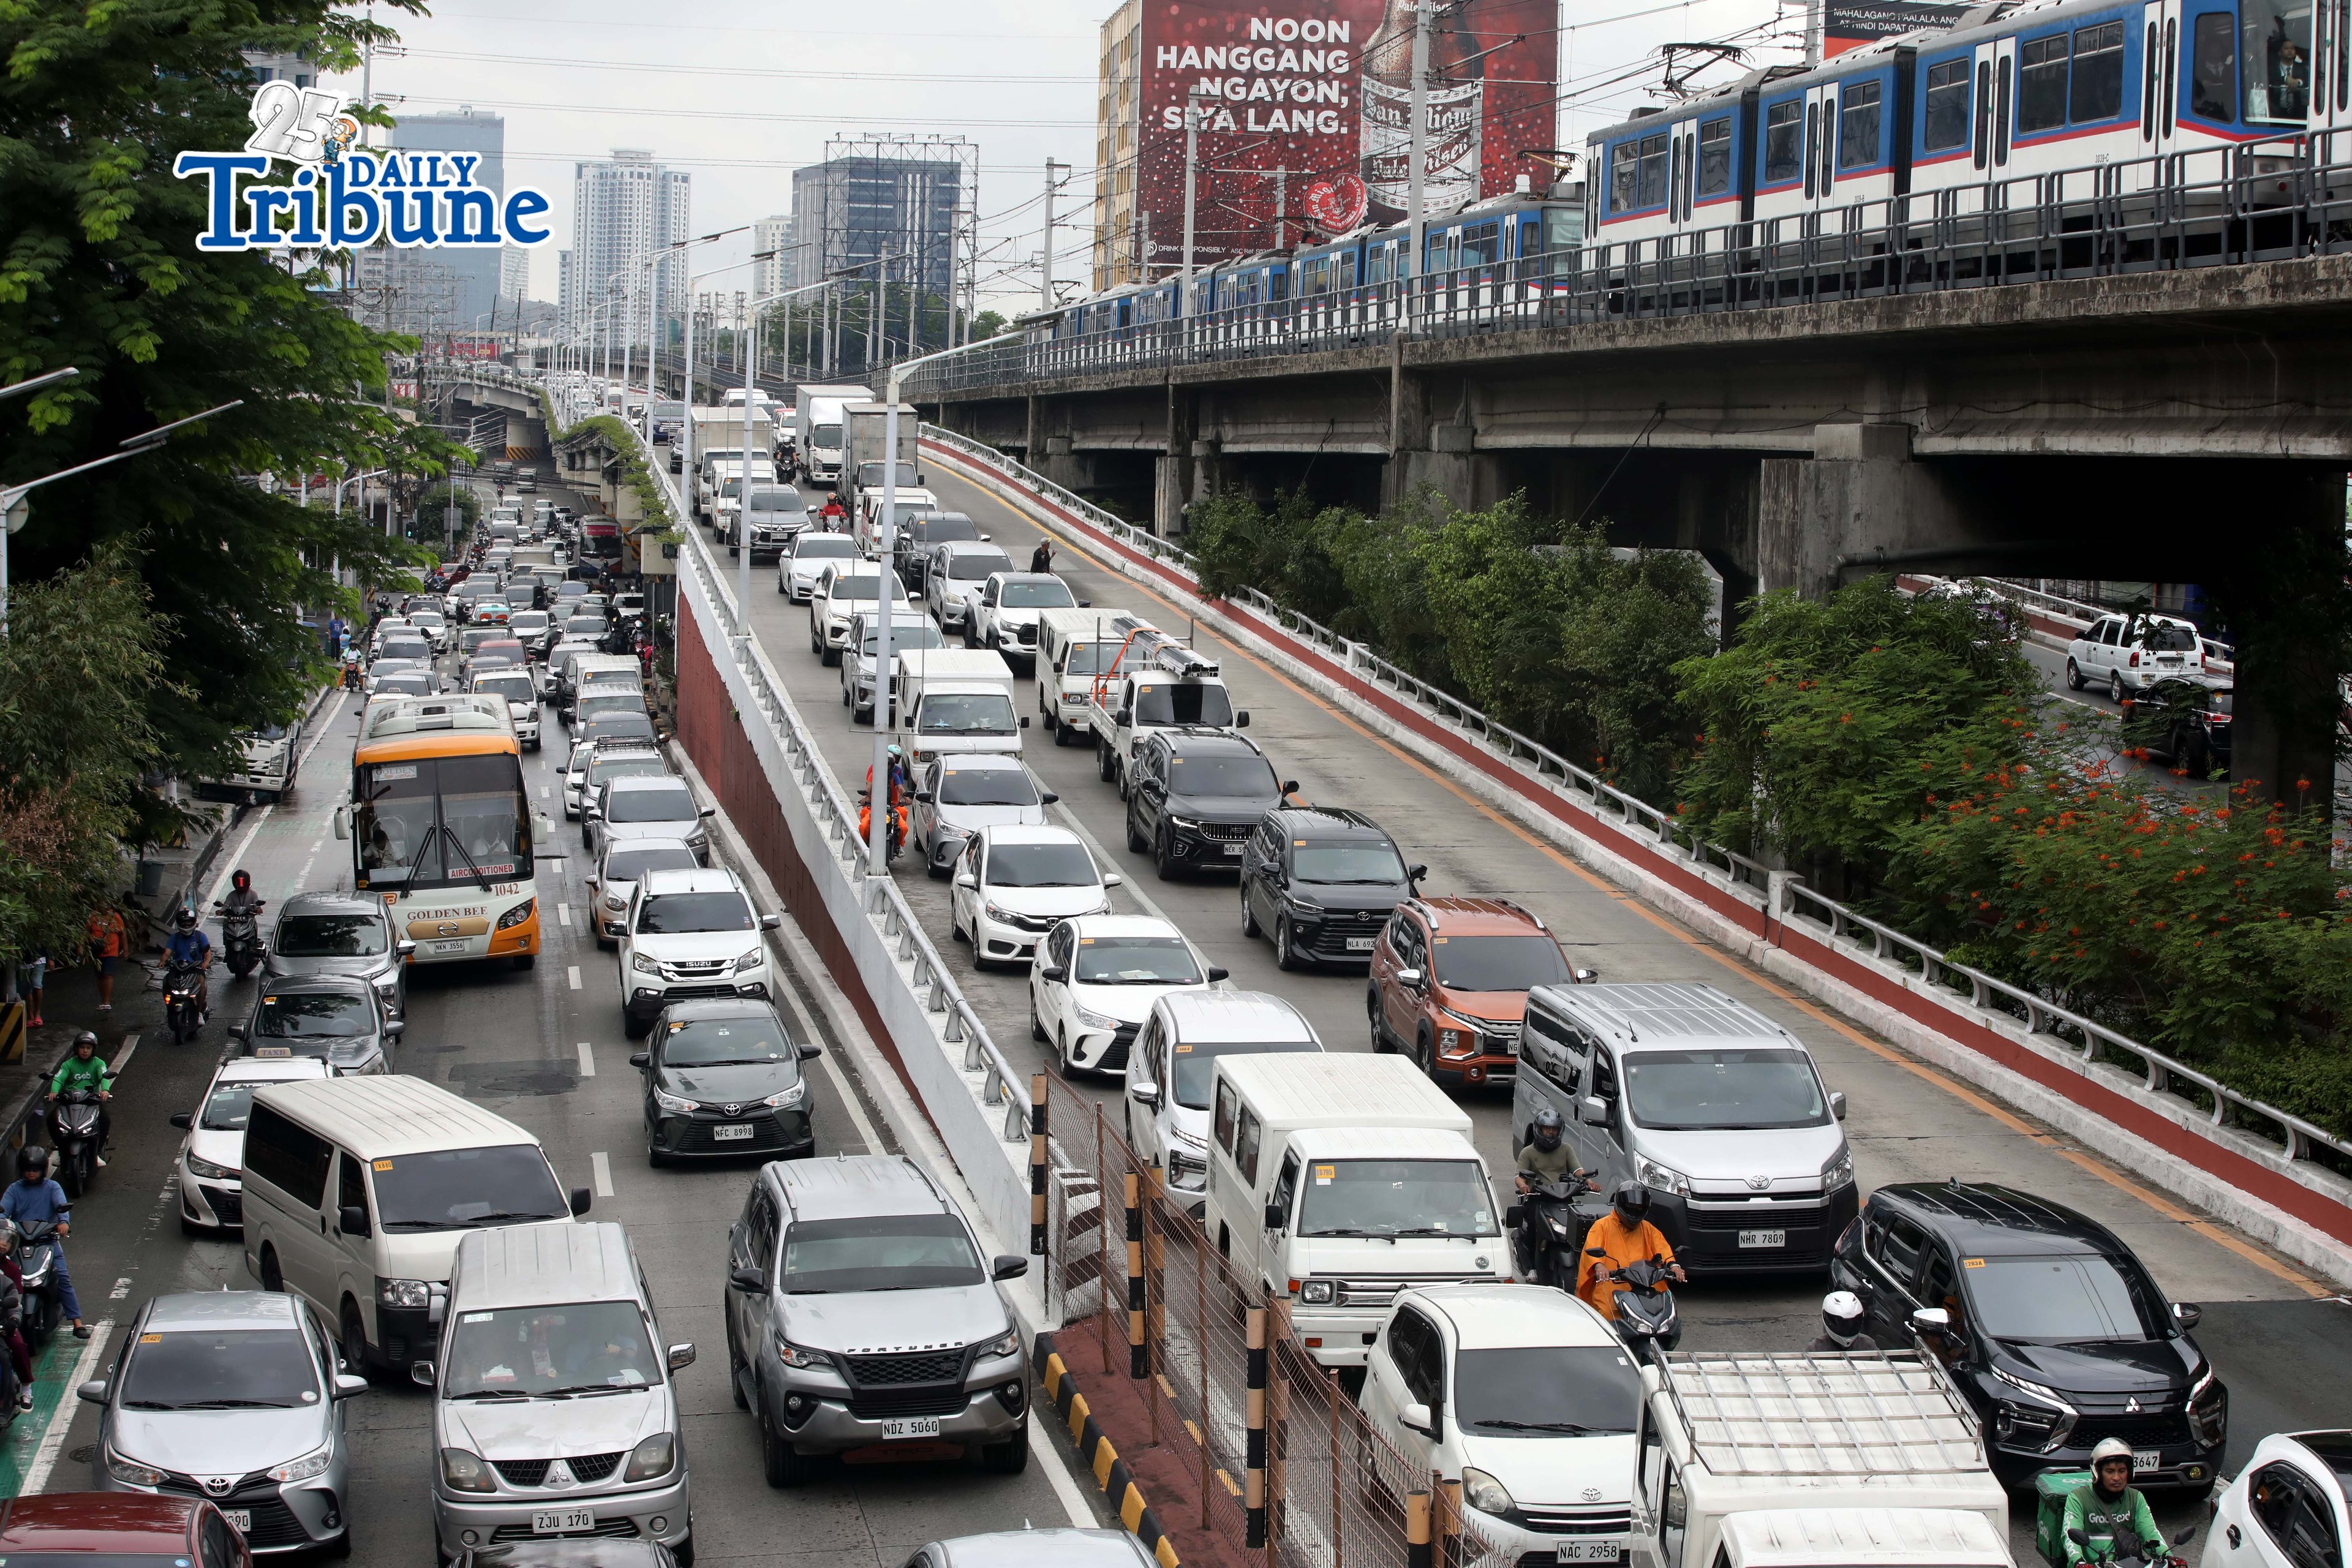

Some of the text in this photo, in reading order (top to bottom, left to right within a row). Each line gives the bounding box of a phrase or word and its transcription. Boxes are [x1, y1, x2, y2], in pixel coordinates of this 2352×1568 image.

[1940, 16, 1959, 25] ANG
[1251, 18, 1349, 43] NOON
[1879, 23, 1906, 32] DAPAT
[1157, 46, 1349, 74] HANGGANG
[1199, 77, 1349, 108] NGAYON,
[1163, 107, 1348, 134] SIYA LANG.
[1347, 177, 1360, 188] PALE
[1325, 210, 1357, 227] PHILIPPINES
[375, 767, 415, 775] GOLDEN
[451, 864, 513, 877] AIRCONDITIONED
[494, 883, 519, 896] 1042
[407, 907, 488, 920] GOLDEN BEE
[715, 1128, 752, 1137] NFC 8998
[1740, 1234, 1784, 1244] NHR 7809
[847, 1341, 964, 1353] FORTUNER
[884, 1421, 938, 1434] NDZ 5060
[2133, 1456, 2158, 1467] 3647
[538, 1513, 589, 1528] ZJU 170
[1559, 1545, 1618, 1559] NAC 2958
